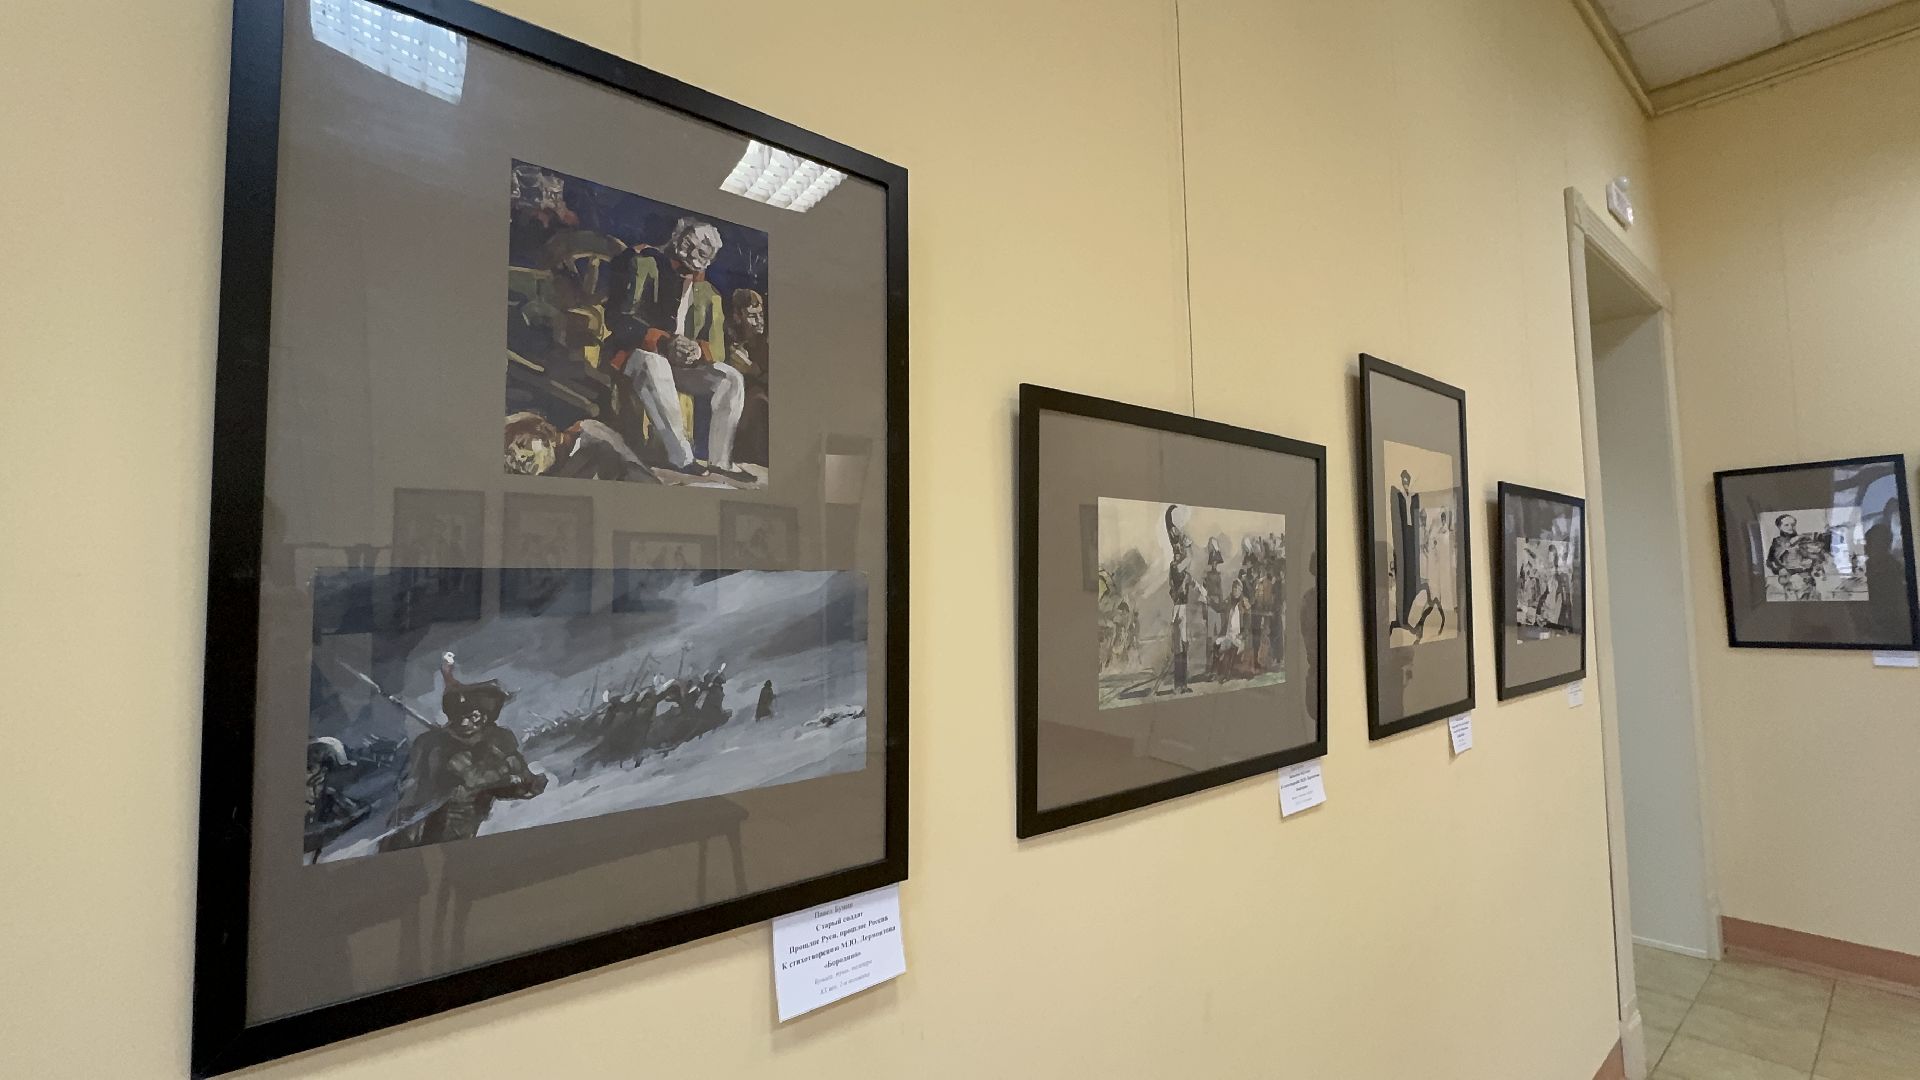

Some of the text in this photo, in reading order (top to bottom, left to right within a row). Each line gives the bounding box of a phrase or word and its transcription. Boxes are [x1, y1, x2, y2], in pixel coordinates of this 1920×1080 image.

[789, 940, 819, 954] Прошлое
[839, 923, 866, 937] прошлое
[868, 916, 889, 926] России
[815, 912, 863, 932] Старый солдат
[782, 960, 788, 970] К
[789, 945, 839, 968] стихотворению
[861, 926, 896, 942] Лермонтова
